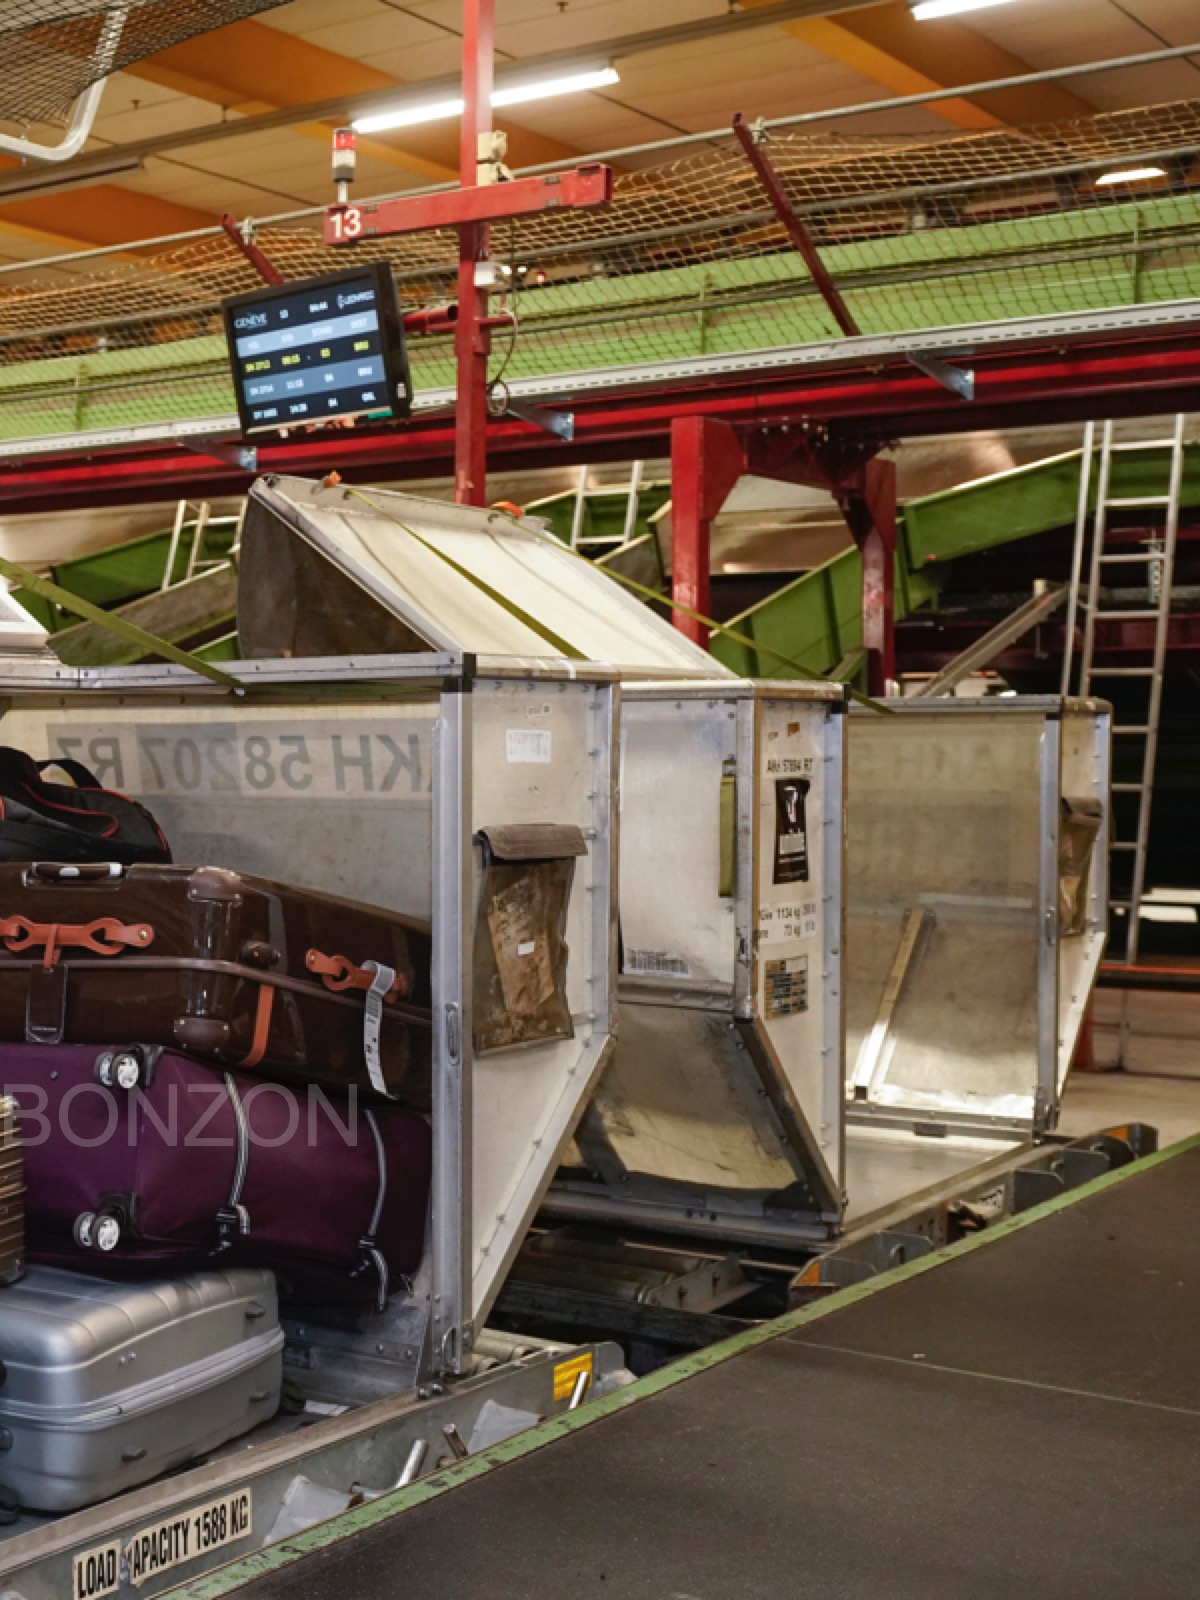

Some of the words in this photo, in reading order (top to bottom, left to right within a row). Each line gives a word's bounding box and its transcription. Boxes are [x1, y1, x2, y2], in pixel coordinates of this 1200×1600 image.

[330, 209, 361, 238] 13
[77, 1547, 117, 1599] LOAD
[194, 1503, 227, 1551] 1588
[230, 1494, 249, 1537] KG
